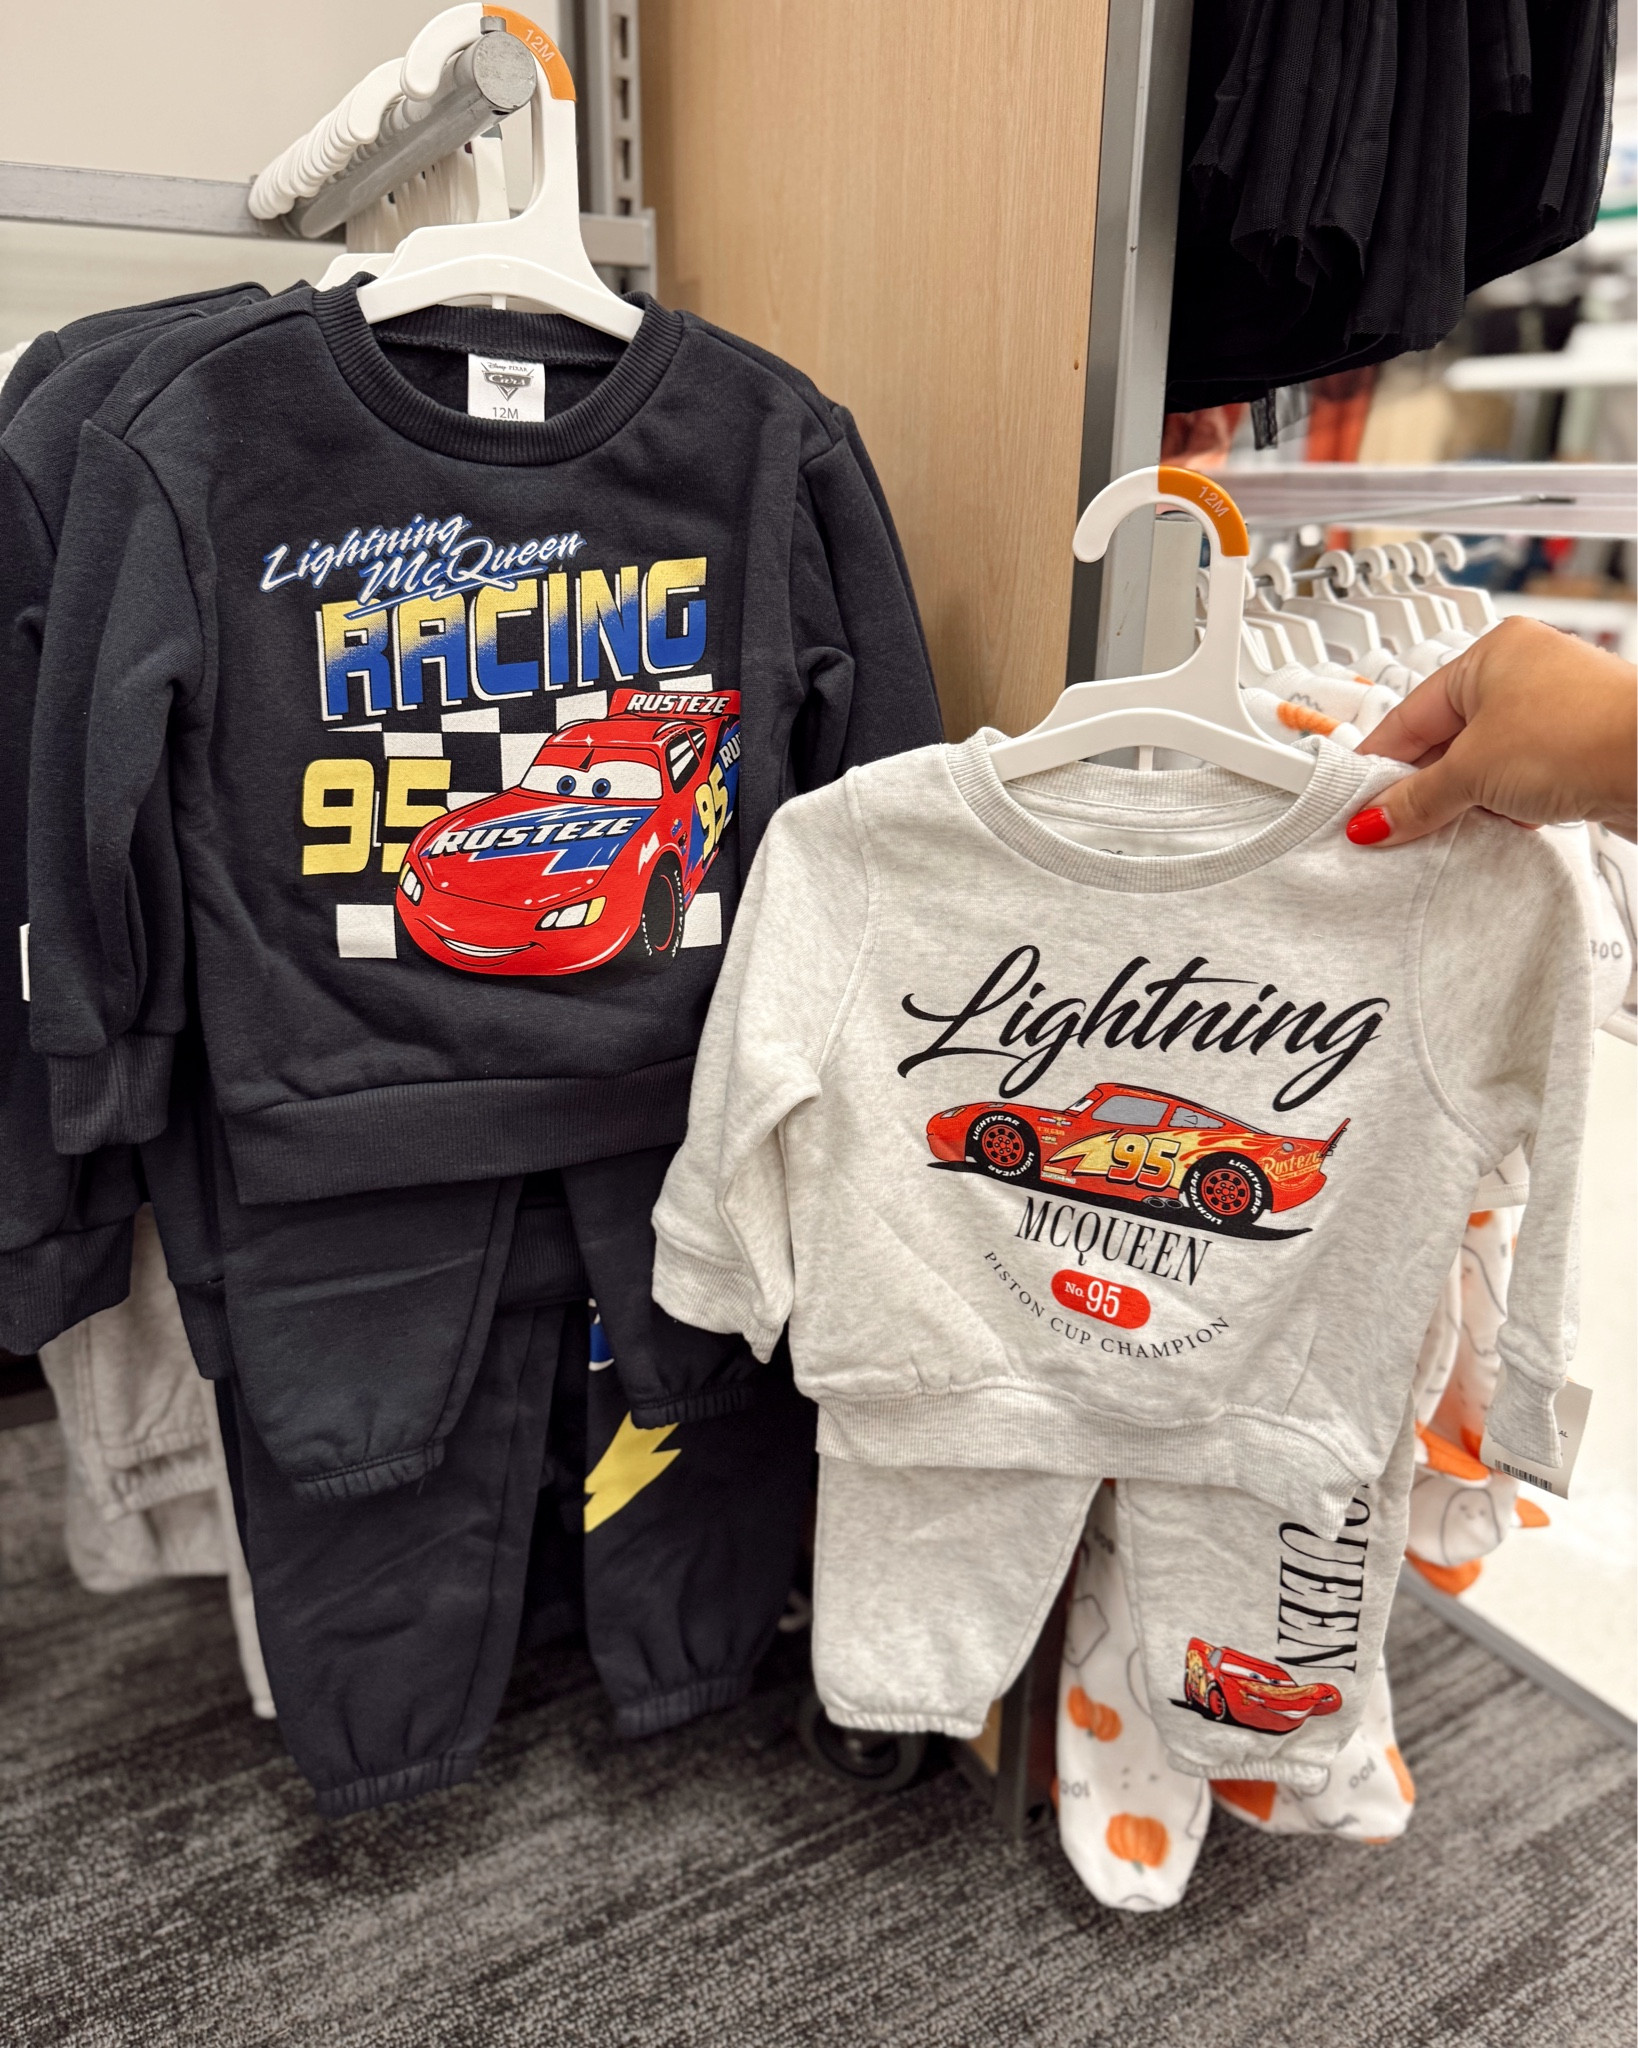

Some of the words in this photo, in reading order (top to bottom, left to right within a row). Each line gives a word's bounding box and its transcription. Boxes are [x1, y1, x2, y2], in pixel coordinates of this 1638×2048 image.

[525, 29, 556, 63] 12M
[492, 407, 519, 420] 12M
[1198, 486, 1230, 518] 12M
[259, 513, 471, 592] Lightning
[357, 531, 587, 606] McQueen
[315, 557, 708, 722] RACING
[625, 693, 731, 714] RUSTEZE
[718, 732, 740, 770] RU
[302, 758, 452, 876] 95
[428, 816, 643, 860] RUSTEZE
[694, 762, 729, 862] 95
[897, 944, 1391, 1112] Lightning
[973, 1115, 1020, 1141] LIGHTYEAR
[987, 1151, 1035, 1177] LIGHTYEAR
[1105, 1133, 1182, 1191] 95
[1228, 1158, 1265, 1214] LIGHTYEAR
[1188, 1170, 1223, 1225] LIGHTYEAR
[1015, 1196, 1213, 1287] MCQUEEN
[983, 1251, 1046, 1318] PISTON
[1050, 1316, 1092, 1346] CUP
[1100, 1316, 1230, 1359] CHAMPION
[1085, 1280, 1122, 1319] 95
